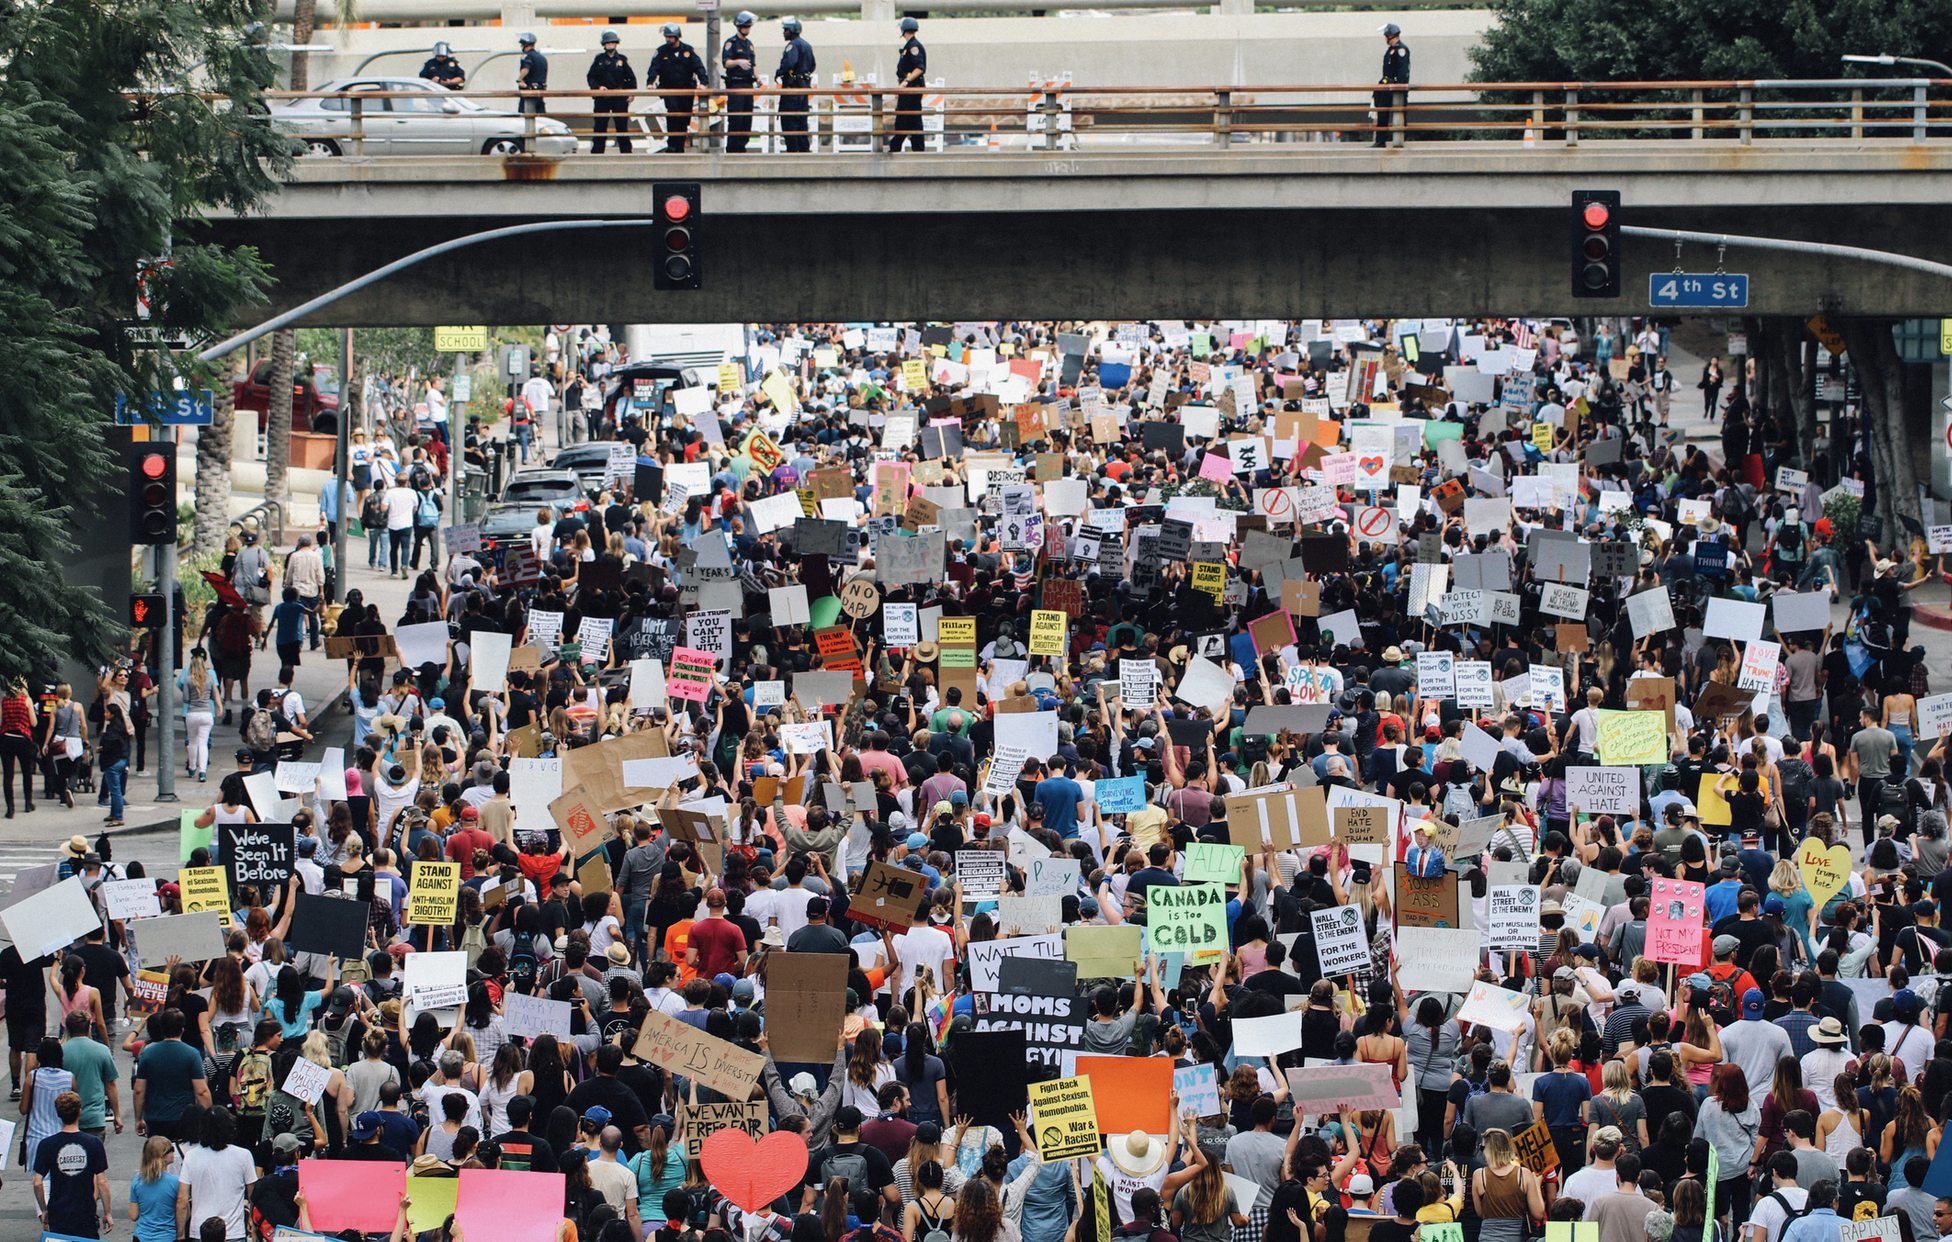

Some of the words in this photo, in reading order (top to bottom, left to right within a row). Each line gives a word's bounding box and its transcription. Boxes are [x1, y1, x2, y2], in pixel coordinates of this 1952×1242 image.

[1658, 279, 1701, 300] 4th
[1712, 282, 1739, 299] St
[440, 337, 483, 347] SCHOOL
[178, 398, 204, 416] St
[988, 471, 1024, 482] OBSTRUCT
[1697, 557, 1725, 569] THINK
[686, 568, 694, 578] 4
[701, 568, 730, 578] YEARS
[1199, 565, 1221, 574] STAND
[1196, 574, 1221, 583] AGAINST
[850, 584, 874, 599] NO
[1442, 590, 1481, 603] PROTECT
[1563, 591, 1578, 600] HATE
[842, 597, 871, 617] DAPL
[1452, 601, 1472, 609] YOUR
[1550, 596, 1558, 604] NO
[1559, 598, 1579, 607] TRUMP
[1037, 613, 1060, 622] STAND
[1444, 608, 1480, 622] PUSSY
[1502, 608, 1516, 618] BAD
[698, 618, 720, 627] YOU
[942, 622, 973, 630] Hillary
[1035, 622, 1061, 631] AGAINST
[693, 626, 724, 637] CAN'T
[819, 632, 844, 642] TRUMP
[700, 636, 719, 644] SIT
[1032, 634, 1063, 642] ANTI-MUSLIM
[696, 643, 722, 651] WITH
[1034, 641, 1060, 650] BIGOTRY!
[1748, 646, 1778, 665] LOVE
[1741, 676, 1769, 694] HATE
[1586, 772, 1625, 784] UNITED
[1102, 788, 1135, 799] SURVIVING
[1578, 785, 1627, 798] AGAINST
[1590, 798, 1621, 811] HATE
[1352, 808, 1368, 818] END
[1348, 818, 1372, 827] HATE
[1350, 826, 1371, 834] DUMP
[229, 829, 270, 847] We've
[1345, 834, 1374, 843] TRUMP
[234, 847, 270, 862] Seen
[272, 842, 289, 861] It
[1192, 846, 1244, 874] ALLY
[194, 868, 215, 876] Resistir
[236, 862, 288, 883] Before
[420, 866, 451, 878] STAND
[962, 868, 1001, 876] NEGAMOS
[1816, 868, 1841, 881] trumps
[416, 878, 453, 890] AGAINST
[1151, 887, 1221, 908] CANADA
[1492, 890, 1510, 898] WALL
[412, 896, 455, 906] ANTI-MUSLIM
[1412, 894, 1441, 909] ASS
[1492, 898, 1516, 906] STREET
[414, 906, 450, 917] BIGOTRY!
[1169, 911, 1178, 921] is
[1183, 910, 1202, 920] too
[1492, 906, 1499, 914] IS
[1500, 906, 1509, 914] THE
[1314, 914, 1334, 924] WALL
[1406, 914, 1418, 922] BAD
[1316, 921, 1340, 931] STREET
[1154, 924, 1217, 946] COLD
[1318, 932, 1324, 940] IS
[1324, 930, 1336, 939] THE
[1490, 935, 1537, 943] IMMIGRANTS
[1655, 927, 1673, 940] NOT
[1678, 928, 1696, 940] MY
[1321, 946, 1339, 956] FOR
[1340, 942, 1357, 952] THE
[1323, 952, 1367, 967] WORKERS
[136, 980, 169, 991] DONALD
[508, 995, 555, 1014] ANGRY
[990, 994, 1071, 1016] MOMS
[506, 1010, 568, 1033] FEMINIST
[642, 1027, 689, 1056] AMERICA
[687, 1042, 710, 1070] IS
[714, 1058, 757, 1085] DIVERSITY
[732, 1052, 753, 1066] HATE
[295, 1074, 319, 1094] MUST
[1040, 1083, 1059, 1093] Fight
[1060, 1080, 1079, 1091] Back
[294, 1084, 309, 1099] GO
[1034, 1096, 1061, 1108] Against
[686, 1105, 710, 1120] WE
[711, 1103, 760, 1119] WANT
[1068, 1122, 1087, 1133] War
[1088, 1120, 1095, 1129] &
[1064, 1132, 1097, 1146] Racism
[1515, 1126, 1551, 1151] HELL
[59, 1154, 86, 1164] CAGEFEST
[1840, 1216, 1900, 1240] RAPISTS
